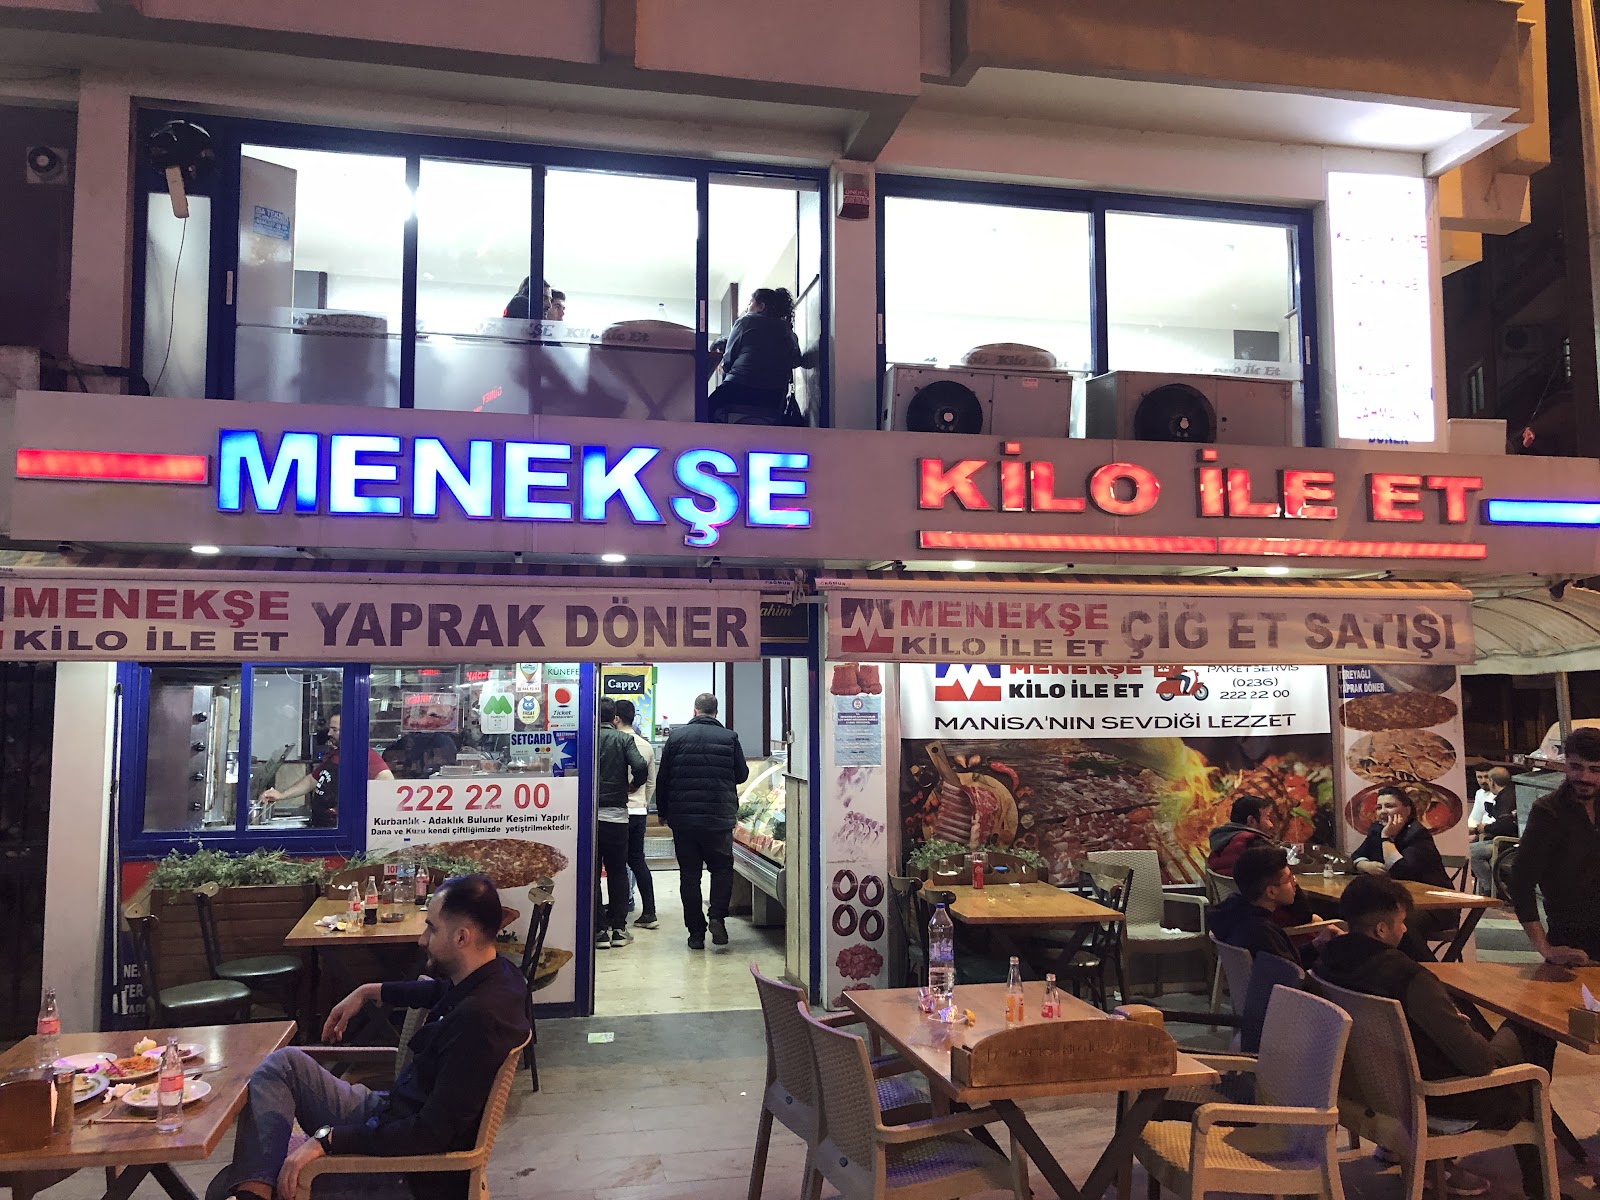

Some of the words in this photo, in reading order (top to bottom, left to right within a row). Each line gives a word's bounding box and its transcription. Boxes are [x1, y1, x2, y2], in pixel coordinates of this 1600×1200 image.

[217, 428, 812, 547] MENEKŞE
[918, 441, 1162, 516] KİLO
[1196, 448, 1338, 520] İLE
[1366, 472, 1483, 524] ET
[14, 587, 290, 628] MENEKŞE
[311, 602, 546, 647] YAPRAK
[565, 596, 750, 648] DÖNER
[900, 599, 1109, 637] MENEKŞE
[14, 625, 129, 651] KİLO
[146, 626, 216, 651] İLE
[233, 631, 289, 651] ET
[1120, 601, 1209, 660] ÇİĞ
[1228, 611, 1288, 649] ET
[1304, 612, 1457, 659] SATIŞI
[901, 632, 986, 656] KİLO
[1000, 634, 1054, 657] İLE
[1066, 639, 1109, 657] ET
[547, 666, 580, 676] KÜNEFE
[1008, 663, 1143, 680] MENEKŞE
[607, 678, 642, 691] Cappy
[1008, 679, 1056, 699] KİLO
[1071, 679, 1109, 699] İLE
[1114, 683, 1144, 698] ET
[1232, 676, 1279, 687] (0236)
[1363, 681, 1386, 692] DÖNER
[1219, 690, 1247, 700] 222
[1250, 690, 1269, 699] 22
[1272, 689, 1291, 698] 00
[934, 714, 1095, 730] MANİSA'NIN
[1101, 712, 1201, 730] SEVDİĞİ
[1208, 713, 1297, 729] LEZZET
[511, 733, 552, 745] SETCARD
[395, 785, 454, 812] 222
[464, 784, 503, 810] 22
[513, 783, 551, 809] 00
[373, 816, 420, 826] Kurbanlık
[428, 816, 465, 825] Adaklık
[467, 815, 504, 824] Bulunur
[506, 814, 538, 823] Kesimi
[541, 813, 571, 823] Yapılır
[405, 827, 426, 835] Kuzu
[428, 826, 450, 834] kendi
[452, 825, 501, 835] çiftliğimizde
